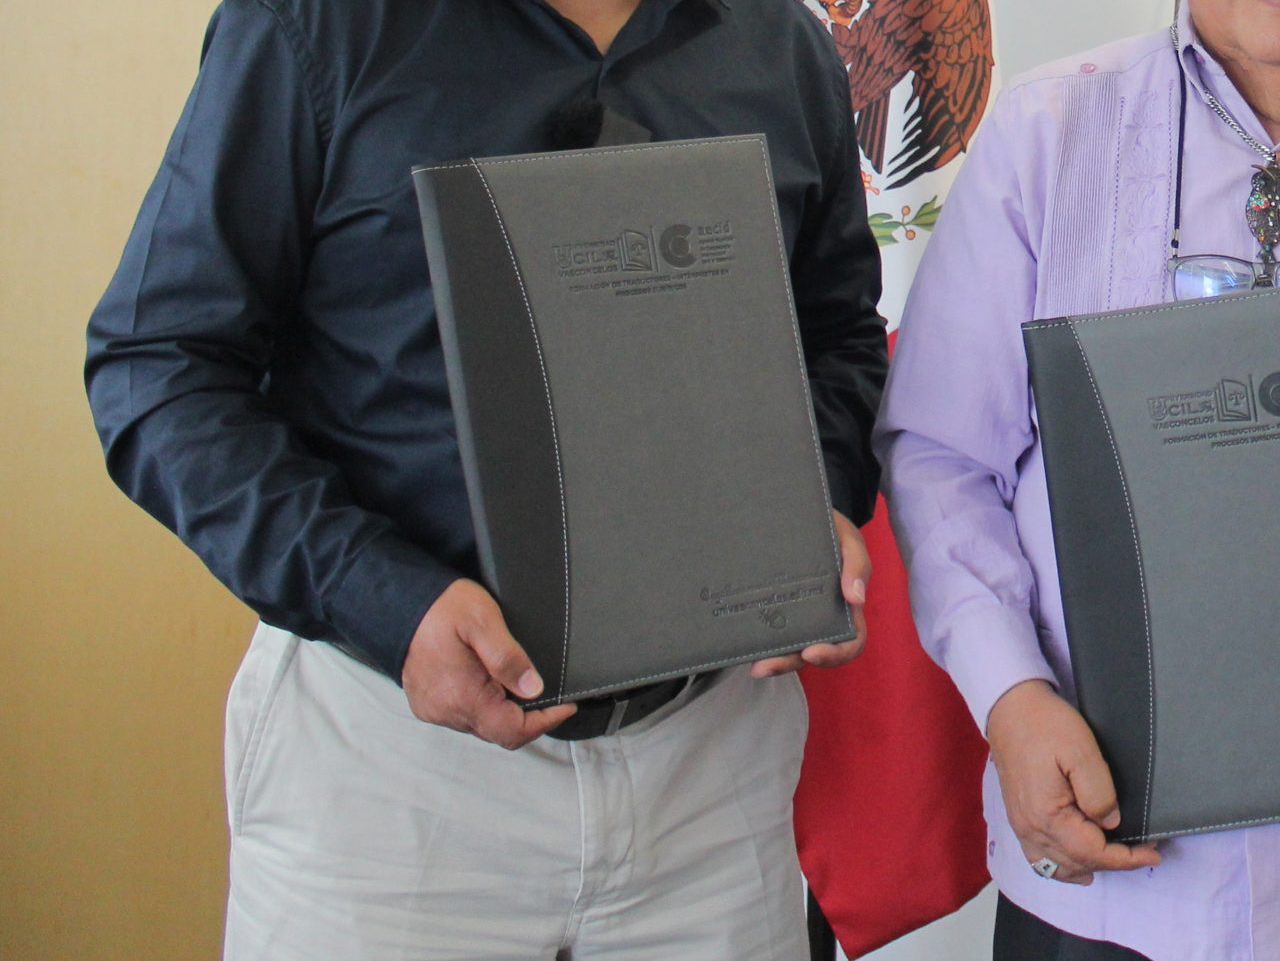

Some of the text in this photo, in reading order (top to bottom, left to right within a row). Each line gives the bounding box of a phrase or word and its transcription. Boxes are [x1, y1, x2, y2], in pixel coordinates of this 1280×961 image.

[1152, 415, 1215, 430] VASCONCELOS
[1208, 430, 1218, 439] DE
[1219, 424, 1271, 439] TRADUCTORES
[1211, 436, 1250, 449] PROCESOS
